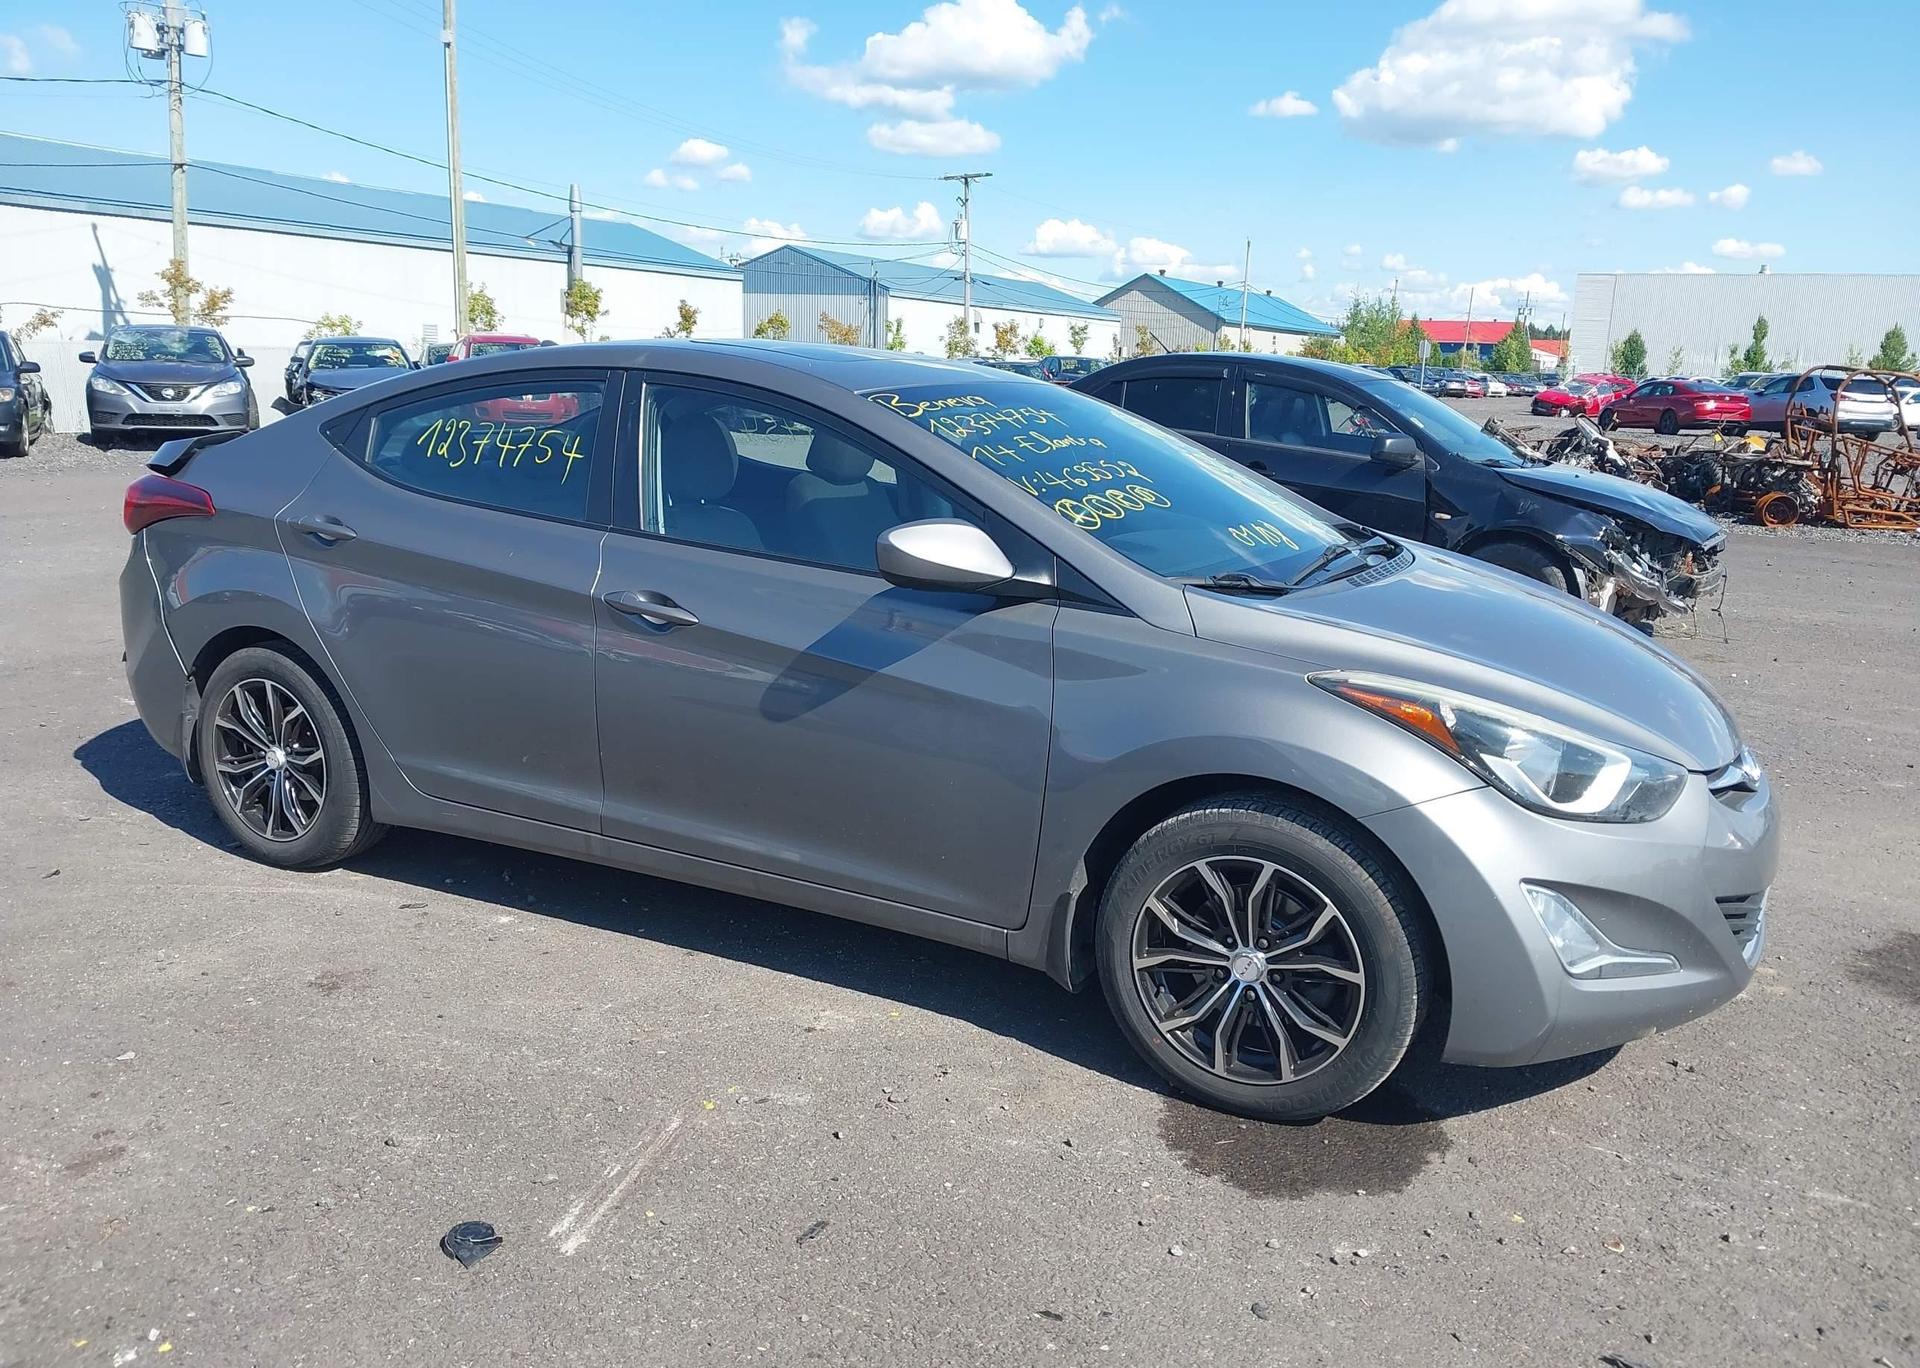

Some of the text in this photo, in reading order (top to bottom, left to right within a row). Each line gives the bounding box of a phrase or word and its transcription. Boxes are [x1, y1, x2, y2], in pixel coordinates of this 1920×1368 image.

[867, 393, 998, 418] Beneva
[929, 406, 1070, 438] 12374754
[417, 418, 585, 485] 12374754
[971, 444, 1026, 466] 14
